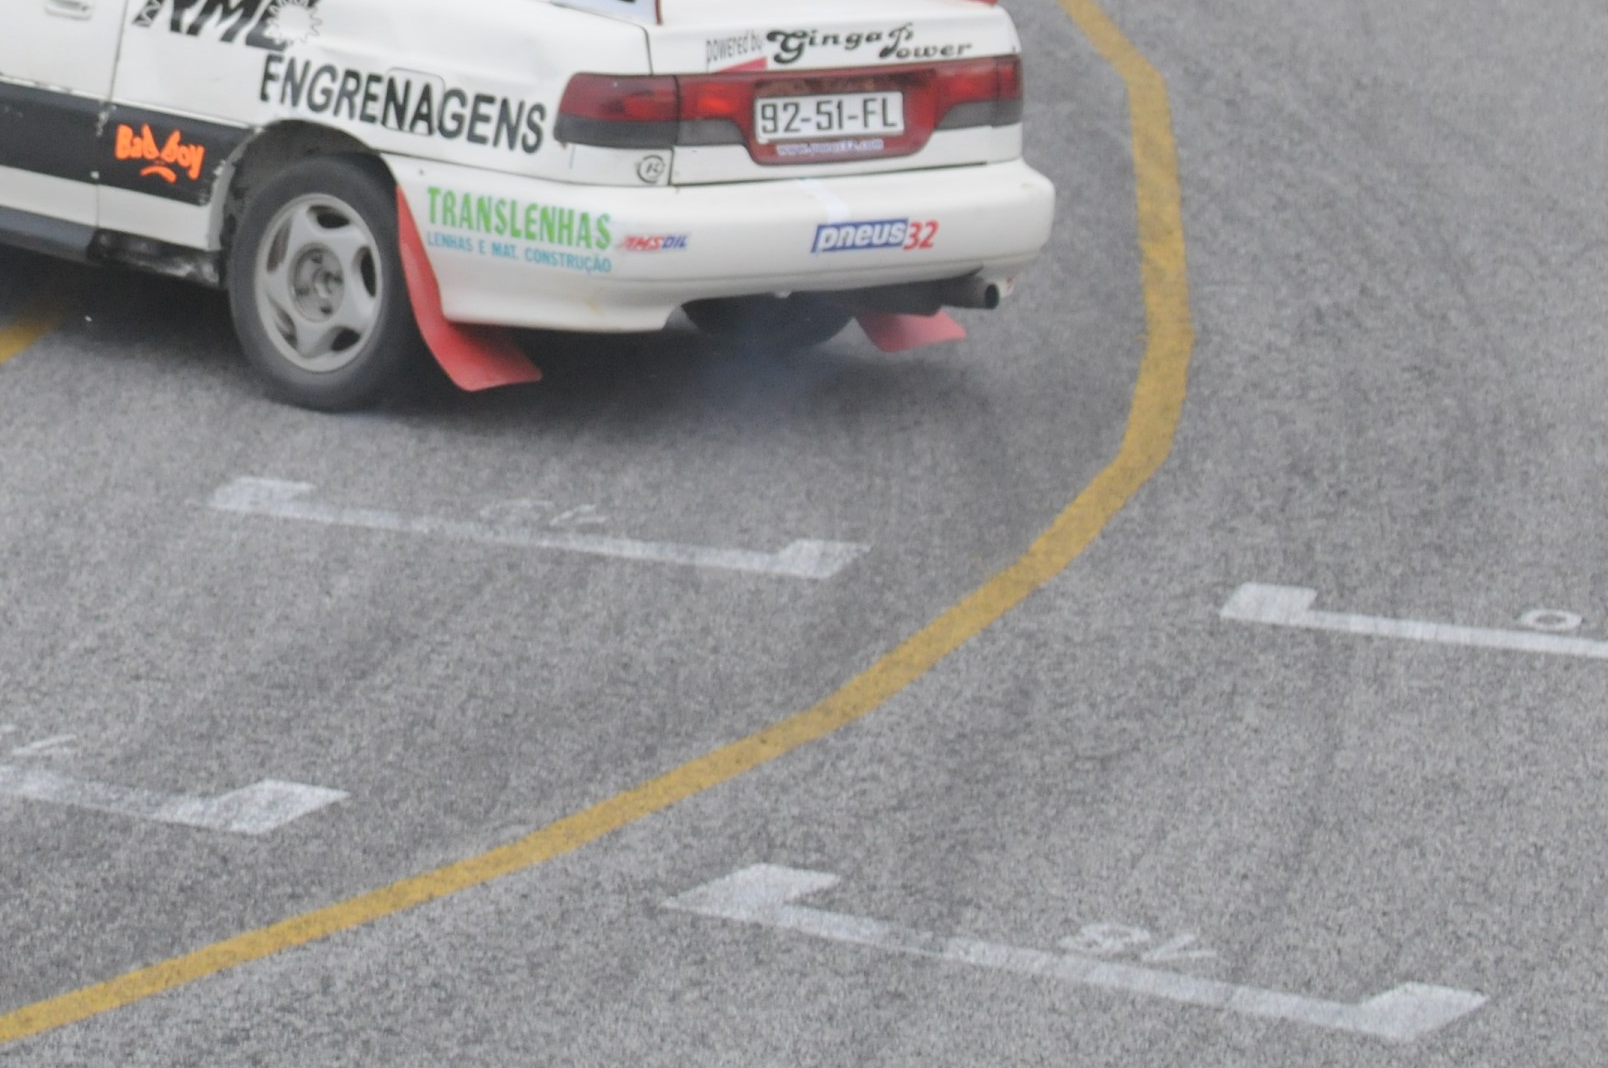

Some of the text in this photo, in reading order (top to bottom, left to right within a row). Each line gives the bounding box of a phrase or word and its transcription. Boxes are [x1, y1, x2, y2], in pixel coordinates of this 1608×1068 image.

[259, 53, 546, 155] ENGRENAGENS
[760, 96, 898, 134] 92-51-FL
[426, 186, 613, 250] TRANSLENHAS
[815, 220, 940, 254] pneus32
[427, 232, 474, 253] LENHAS
[478, 239, 487, 254] E
